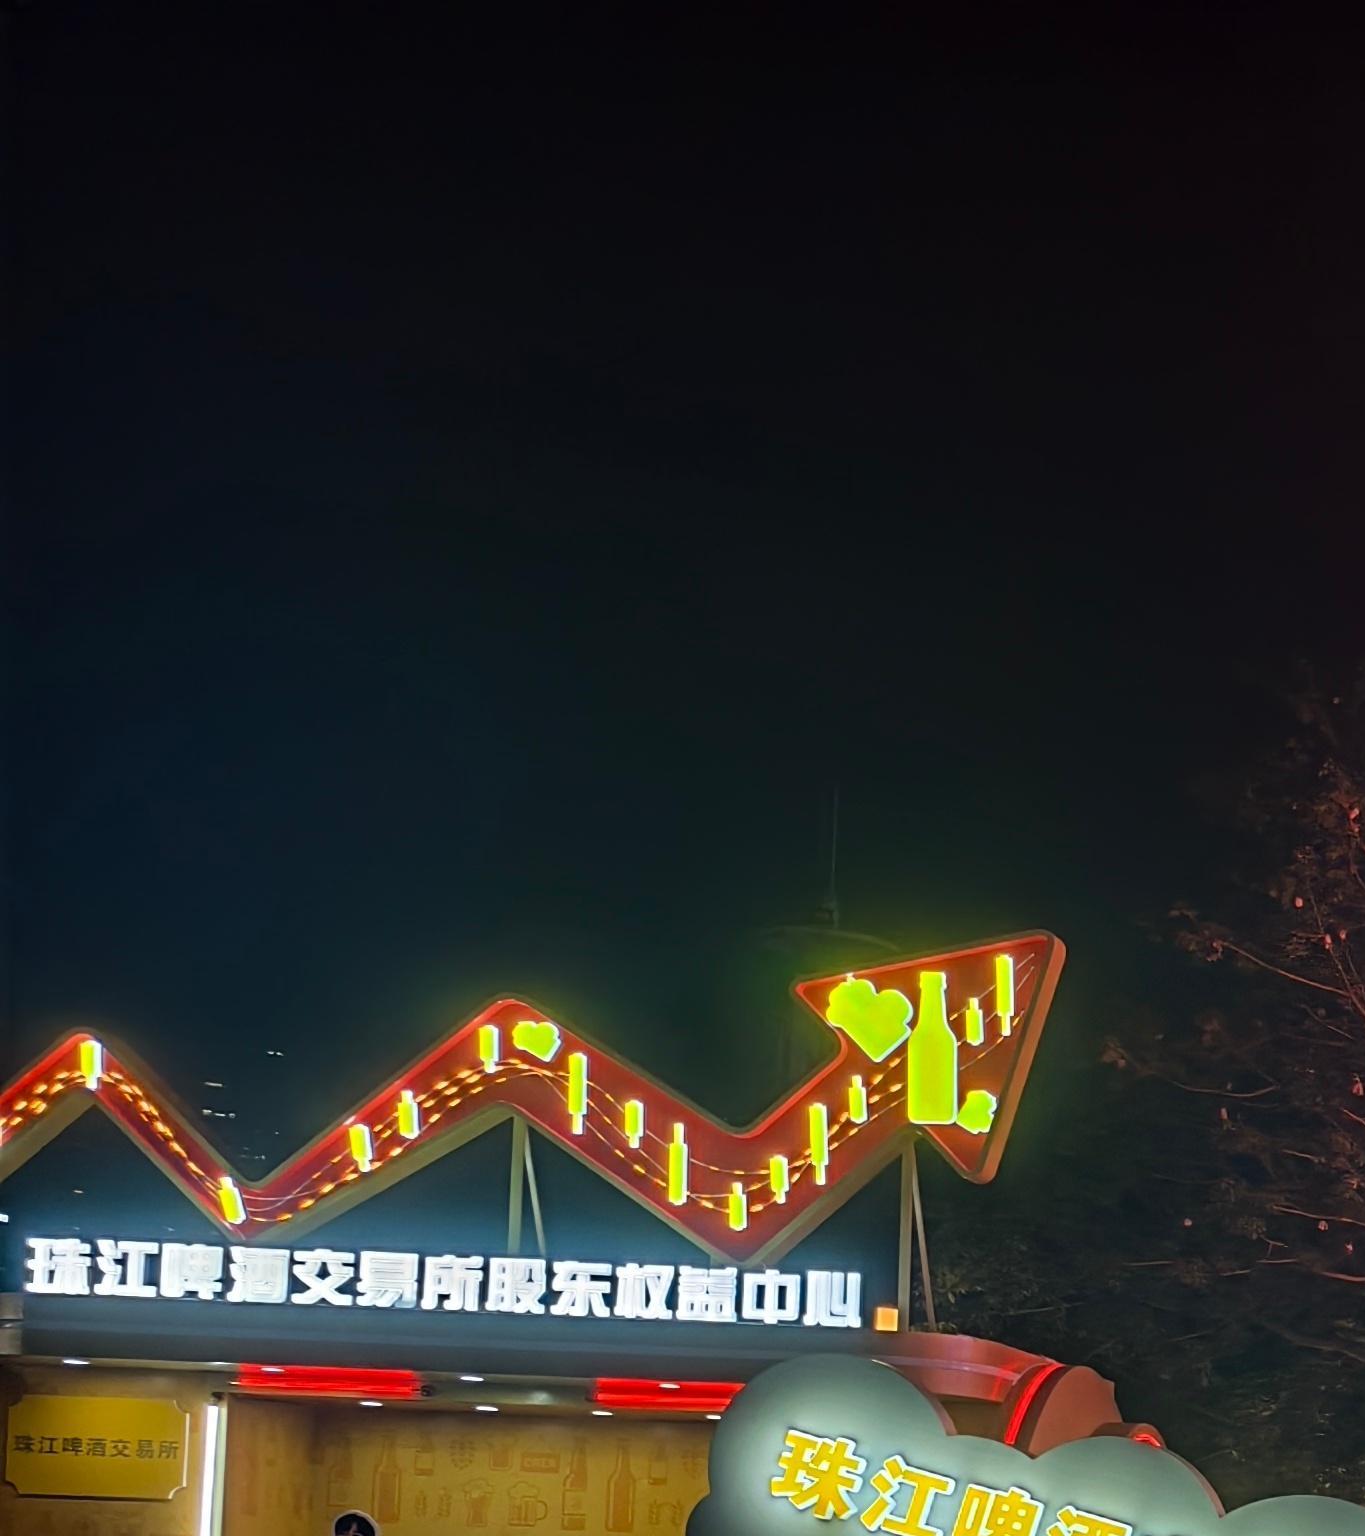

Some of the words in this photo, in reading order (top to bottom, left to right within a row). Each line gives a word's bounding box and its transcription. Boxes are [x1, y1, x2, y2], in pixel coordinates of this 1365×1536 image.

[24, 1237, 862, 1329] 珠江啤酒交易所股东权益中心
[14, 1434, 180, 1460] 珠江啤酒交易所
